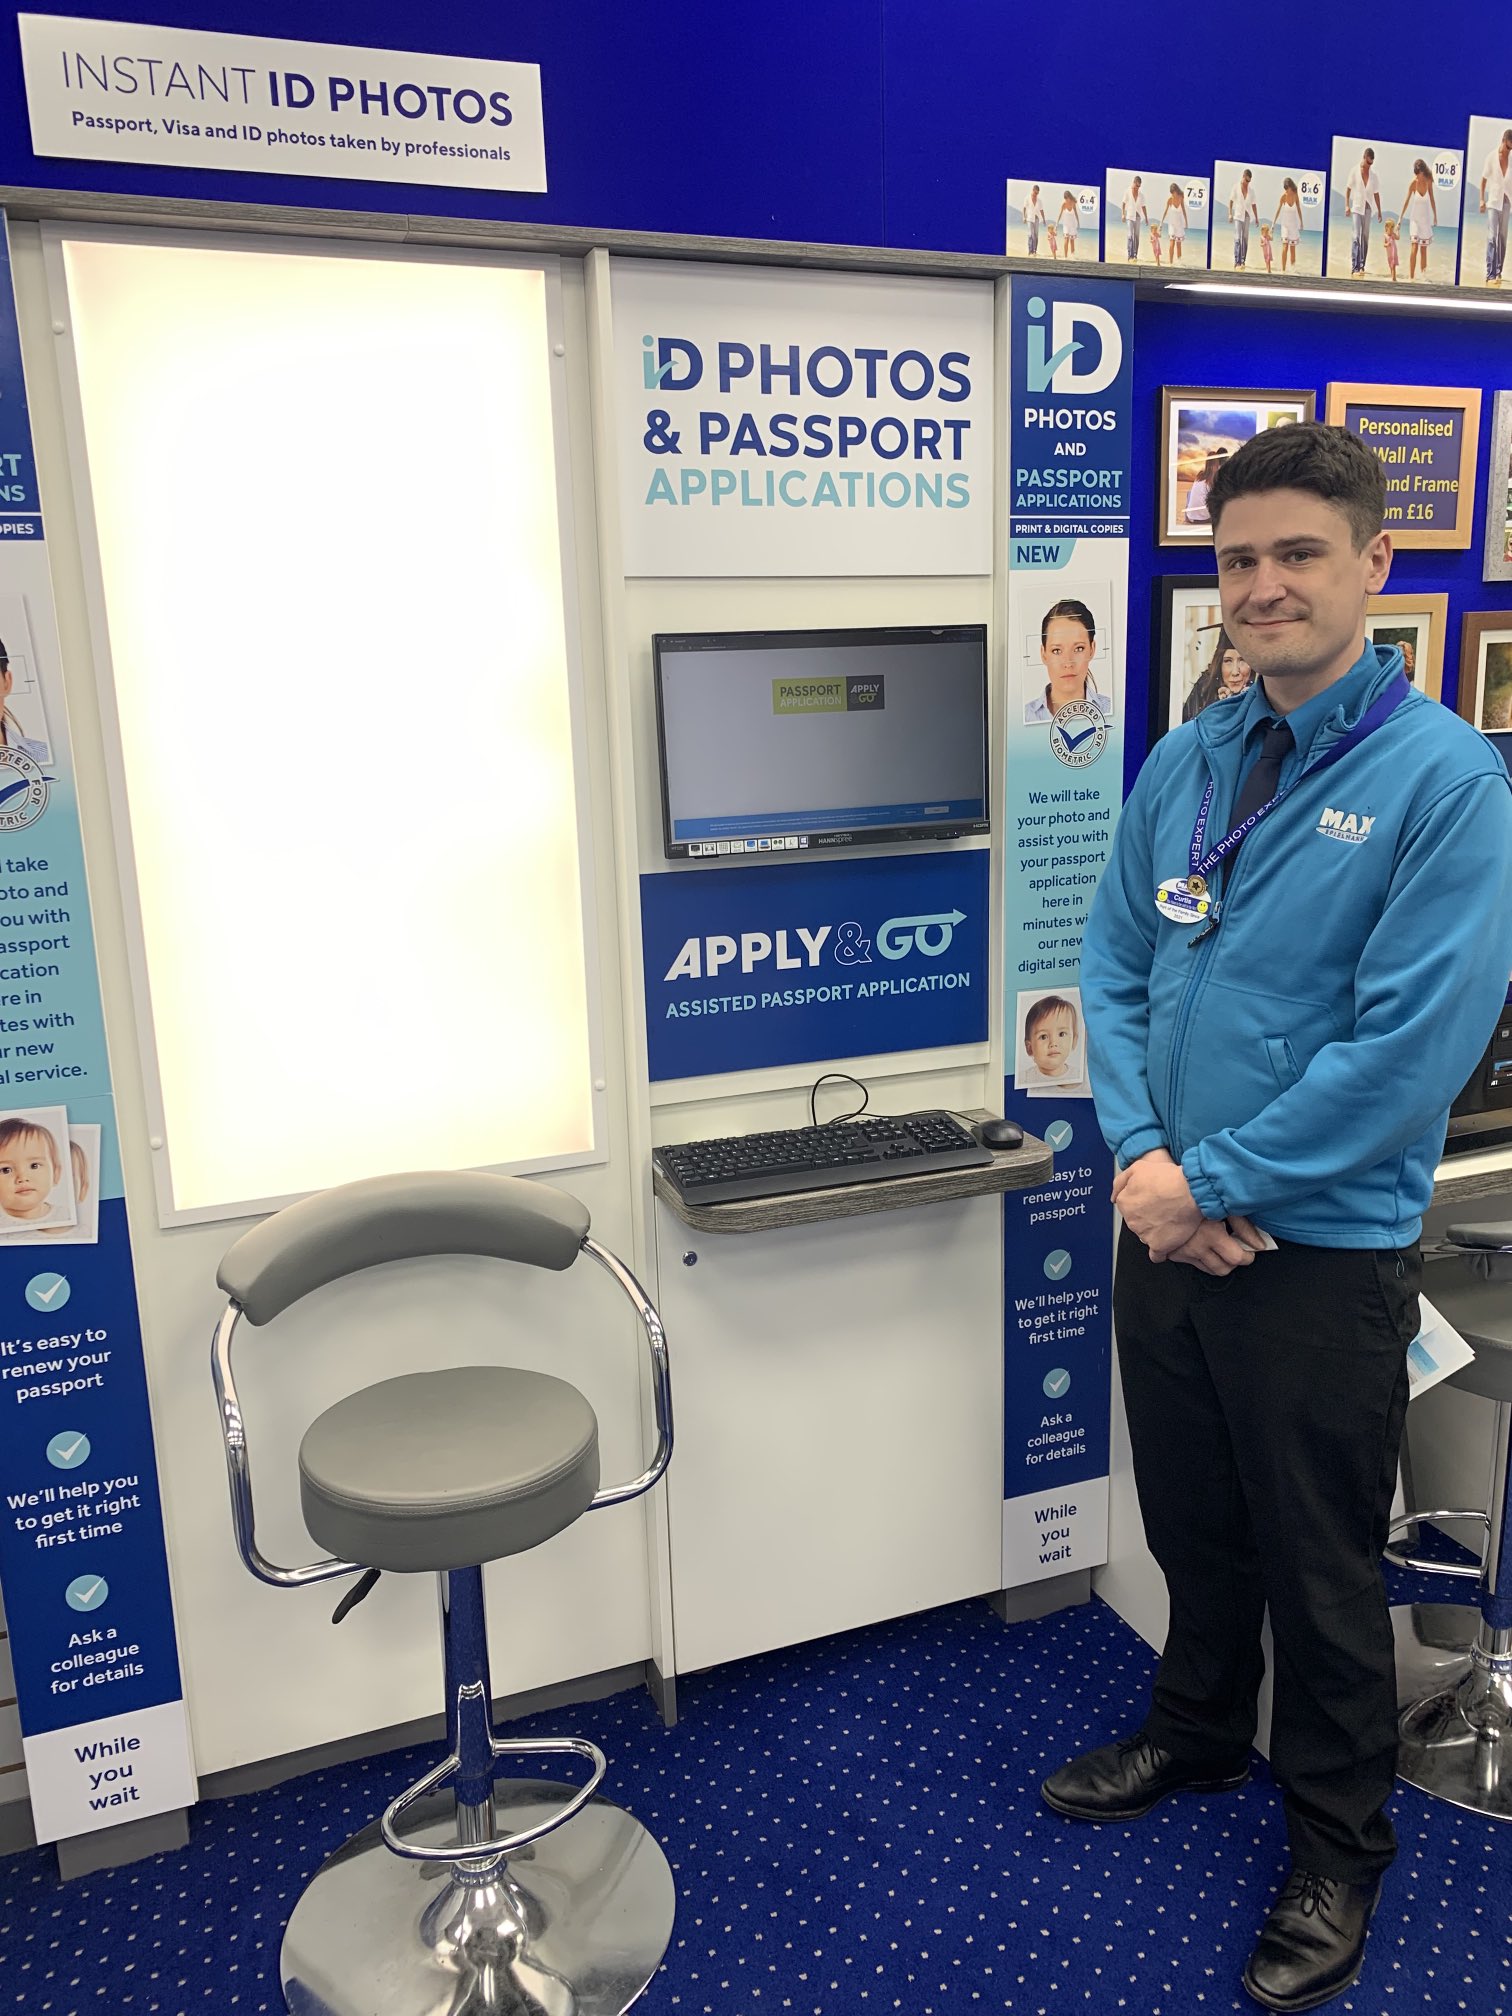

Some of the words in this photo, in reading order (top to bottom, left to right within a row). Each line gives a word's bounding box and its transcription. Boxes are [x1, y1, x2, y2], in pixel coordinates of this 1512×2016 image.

[61, 51, 255, 104] INSTANT
[269, 72, 315, 109] ID
[328, 77, 513, 127] PHOTOS
[72, 111, 158, 137] Passport,
[162, 119, 200, 137] Visa
[205, 124, 238, 140] and
[242, 125, 262, 141] ID
[267, 127, 326, 148] photos
[330, 132, 377, 151] taken
[381, 137, 400, 156] by
[404, 139, 511, 161] professionals
[719, 341, 972, 402] PHOTOS
[1024, 408, 1116, 431] PHOTOS
[1360, 417, 1454, 437] Personalised
[643, 409, 682, 455] &
[700, 411, 971, 461] PASSPORT
[1054, 442, 1087, 456] AND
[1373, 446, 1406, 464] Wall
[1409, 447, 1434, 464] Art
[645, 467, 970, 509] APPLICATIONS
[1016, 469, 1123, 488] PASSPORT
[1414, 475, 1459, 493] Frame
[1016, 494, 1122, 508] APPLICATIONS
[1407, 503, 1434, 520] £16
[0, 523, 35, 535] PIES
[1015, 524, 1043, 534] PRINT
[1044, 524, 1052, 534] &
[1053, 524, 1089, 534] DIGITAL
[1090, 524, 1124, 534] COPIES
[1017, 545, 1060, 563] NEW
[780, 685, 841, 697] PASSPORT
[850, 684, 881, 693] APPLY
[859, 693, 877, 703] GO
[780, 696, 841, 708] APPLICATION
[1058, 704, 1100, 723] ACCEPTED
[1095, 727, 1104, 748] FOR
[1053, 738, 1092, 763] BIOMETRIC
[31, 779, 42, 805] FOR
[1029, 792, 1048, 804] We
[1051, 790, 1071, 802] will
[1074, 788, 1100, 801] take
[1018, 815, 1046, 829] your
[1049, 812, 1085, 827] photo
[1088, 808, 1110, 820] and
[1319, 807, 1377, 834] MAX
[1018, 834, 1054, 847] assist
[1057, 834, 1079, 848] you
[1082, 830, 1108, 842] with
[1197, 851, 1220, 874] THE
[1216, 816, 1256, 854] PHOTO
[5, 857, 49, 873] take
[1020, 858, 1048, 871] your
[1051, 851, 1105, 868] passport
[34, 881, 68, 898] and
[1029, 873, 1096, 891] application
[1042, 897, 1070, 908] here
[1072, 895, 1083, 905] in
[1173, 894, 1192, 905] Curtis
[28, 908, 70, 925] with
[1023, 916, 1072, 930] minutes
[1075, 914, 1088, 926] wi
[1038, 939, 1059, 949] our
[1061, 936, 1083, 947] new
[664, 926, 832, 981] APPLY
[0, 963, 59, 980] cation
[1018, 958, 1056, 974] digital
[1058, 959, 1081, 968] serv
[0, 994, 21, 1006] re
[25, 990, 42, 1004] in
[666, 995, 756, 1018] ASSISTED
[761, 984, 853, 1008] PASSPORT
[857, 972, 970, 998] APPLICATION
[33, 1012, 75, 1029] with
[16, 1043, 54, 1057] new
[15, 1065, 88, 1083] service.
[1079, 1166, 1092, 1178] to
[1023, 1191, 1062, 1205] renew
[1064, 1184, 1094, 1201] your
[1030, 1203, 1086, 1225] passport
[1048, 1291, 1074, 1306] help
[1076, 1288, 1099, 1304] you
[1018, 1317, 1032, 1329] to
[1034, 1313, 1056, 1330] get
[1057, 1310, 1067, 1322] it
[1069, 1304, 1099, 1322] right
[36, 1331, 82, 1351] easy
[85, 1328, 107, 1343] to
[1028, 1331, 1054, 1345] first
[1057, 1326, 1086, 1340] time
[1, 1361, 63, 1380] renew
[66, 1349, 112, 1373] your
[16, 1373, 104, 1404] passport
[1040, 1414, 1063, 1428] Ask
[1065, 1413, 1073, 1423] a
[1027, 1427, 1086, 1448] colleague
[1025, 1452, 1044, 1465] for
[1046, 1443, 1086, 1462] details
[59, 1481, 100, 1500] help
[103, 1475, 139, 1495] you
[15, 1516, 37, 1531] to
[41, 1509, 74, 1530] get
[77, 1503, 92, 1518] it
[95, 1494, 141, 1519] right
[1034, 1504, 1078, 1524] While
[35, 1530, 76, 1549] first
[79, 1521, 123, 1541] time
[1041, 1526, 1070, 1547] you
[1038, 1545, 1072, 1564] wait
[68, 1629, 103, 1648] Ask
[106, 1627, 117, 1639] a
[50, 1643, 140, 1673] colleague
[50, 1678, 78, 1695] for
[83, 1663, 144, 1687] details
[74, 1736, 141, 1763] While
[89, 1764, 133, 1791] you
[89, 1786, 141, 1811] wait
